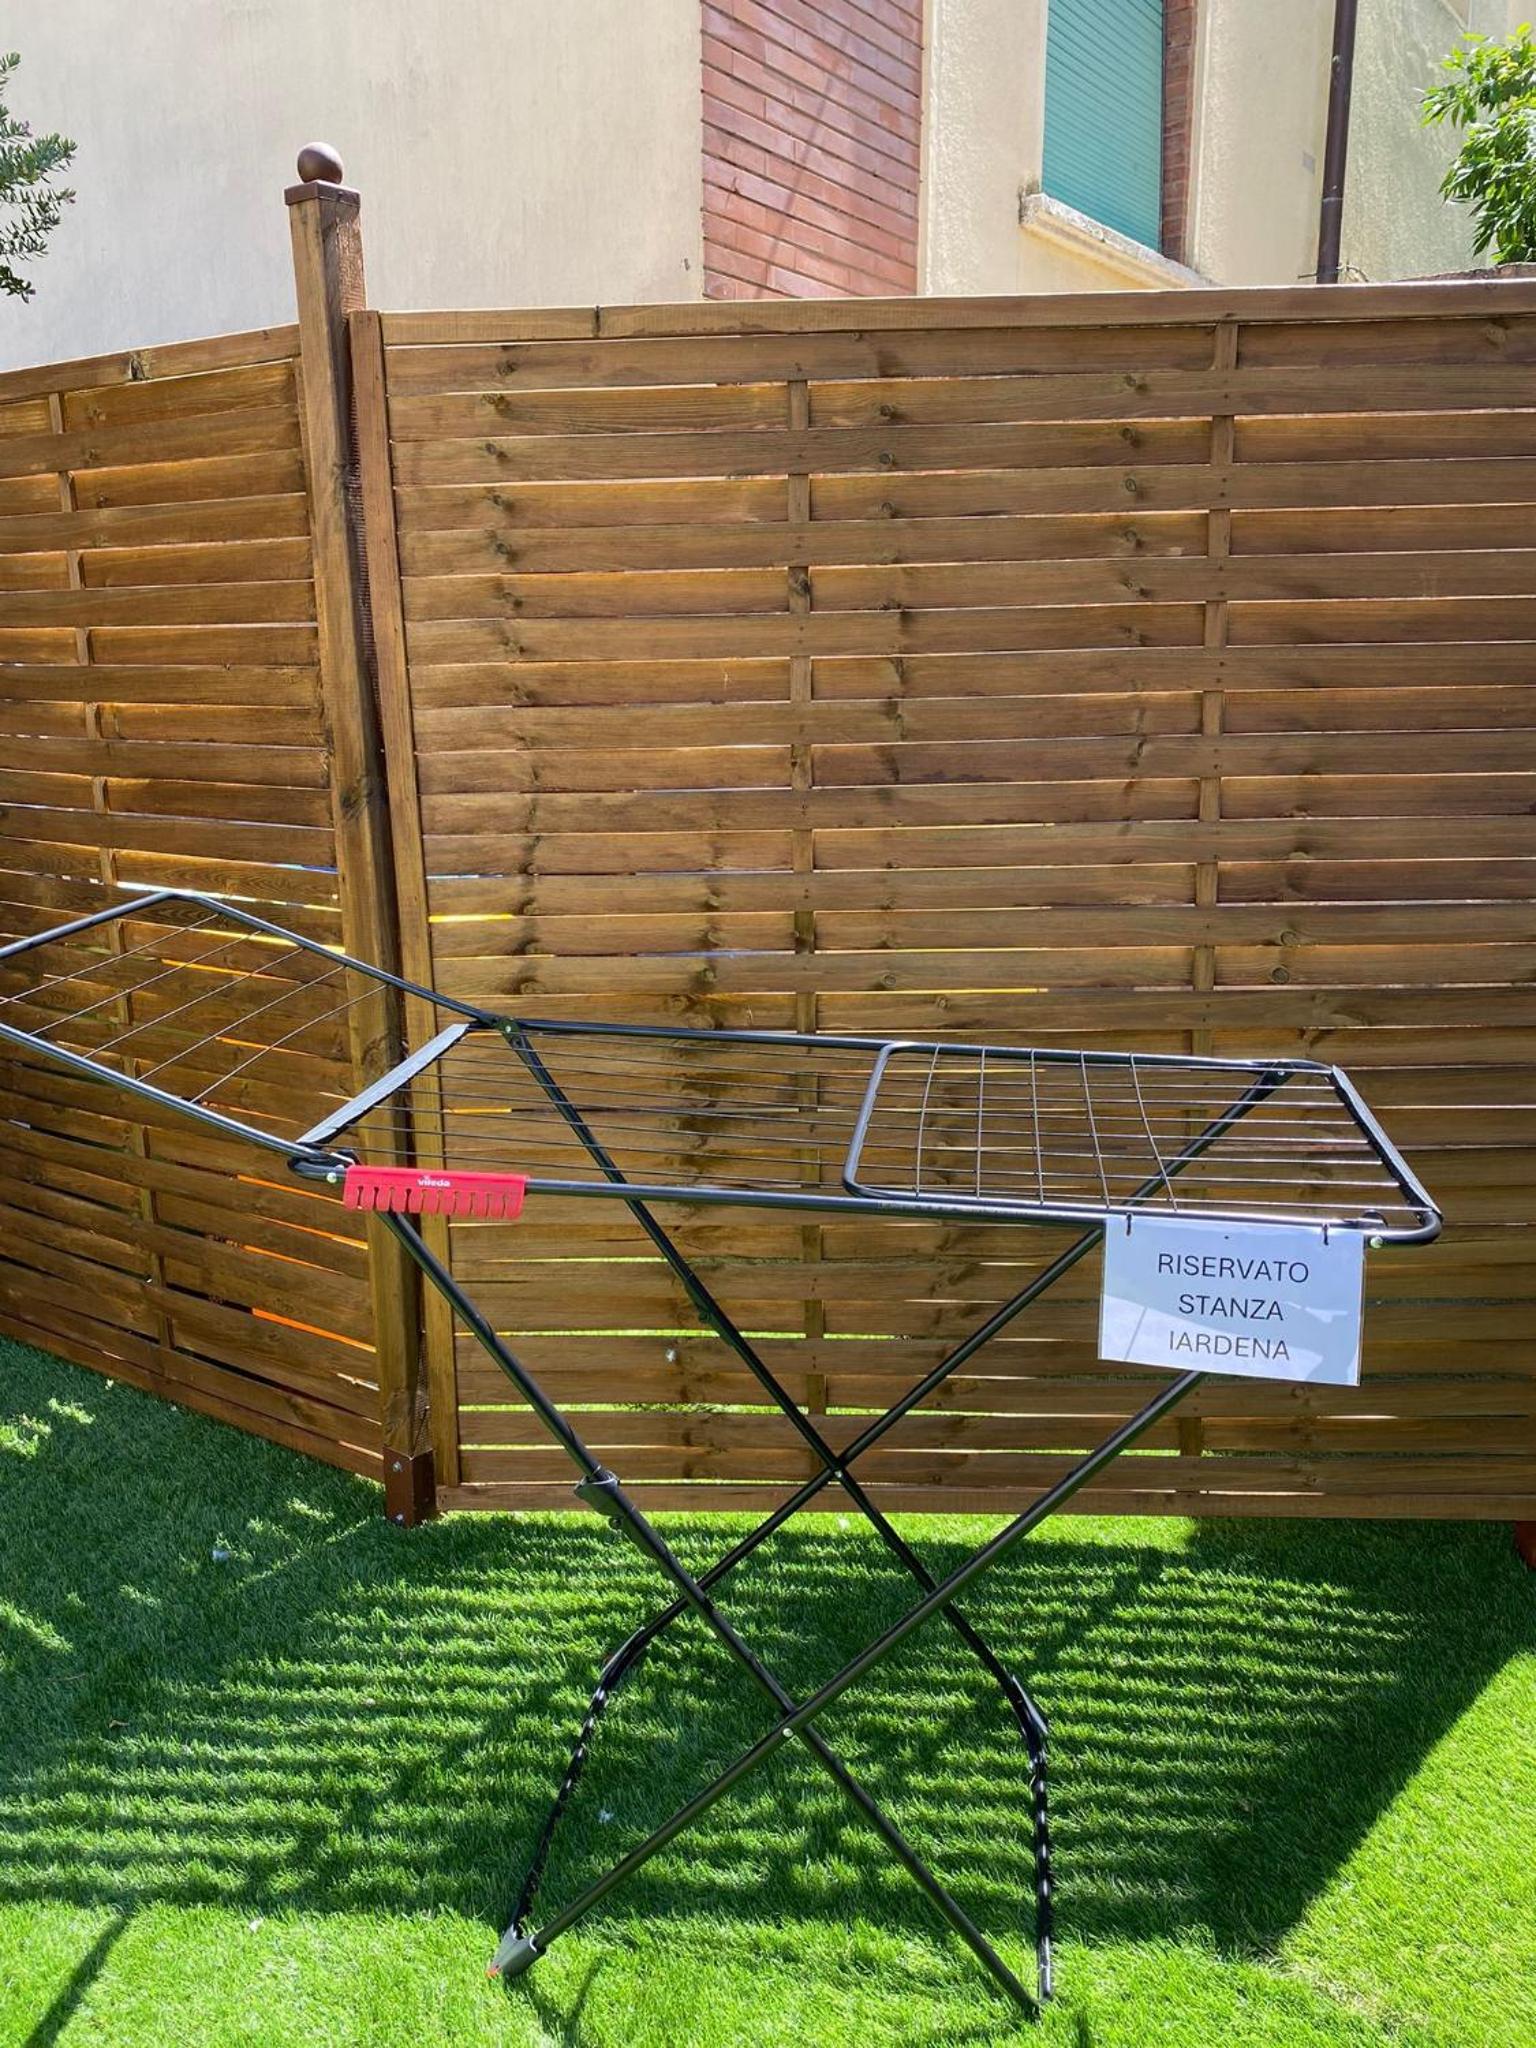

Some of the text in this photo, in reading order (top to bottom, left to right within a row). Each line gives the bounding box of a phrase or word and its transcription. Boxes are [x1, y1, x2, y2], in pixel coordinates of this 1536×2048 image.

[1157, 1253, 1309, 1283] RISERVATO
[1178, 1293, 1284, 1321] STANZA
[1169, 1330, 1290, 1360] IARDENA
